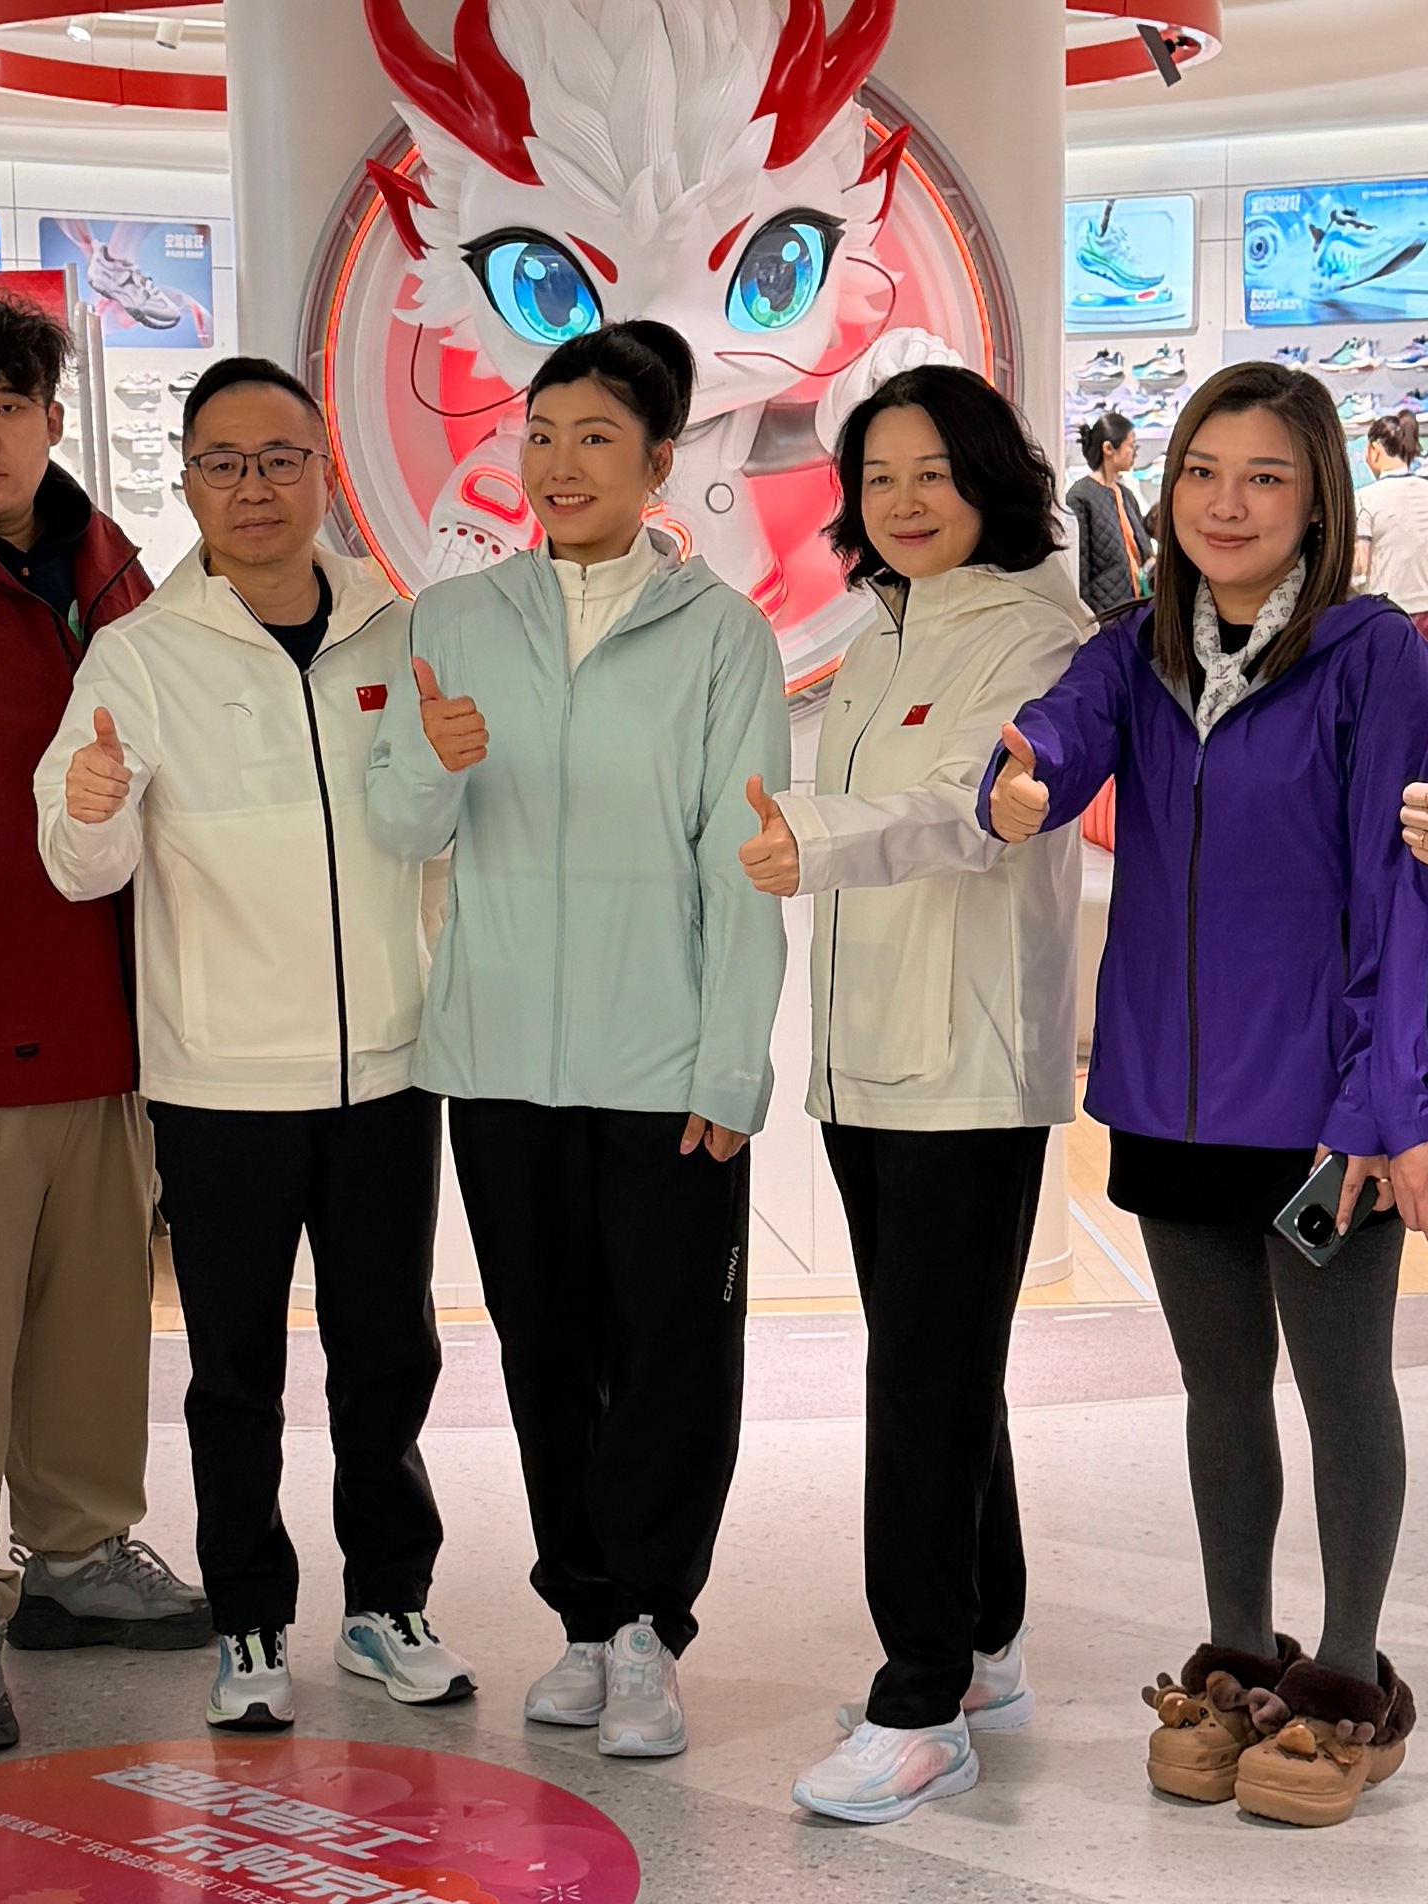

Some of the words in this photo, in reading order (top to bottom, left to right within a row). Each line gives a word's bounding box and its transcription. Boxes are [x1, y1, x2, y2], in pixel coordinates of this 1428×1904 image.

[723, 1245, 741, 1303] CHINA
[91, 1761, 433, 1860] 超级晋江
